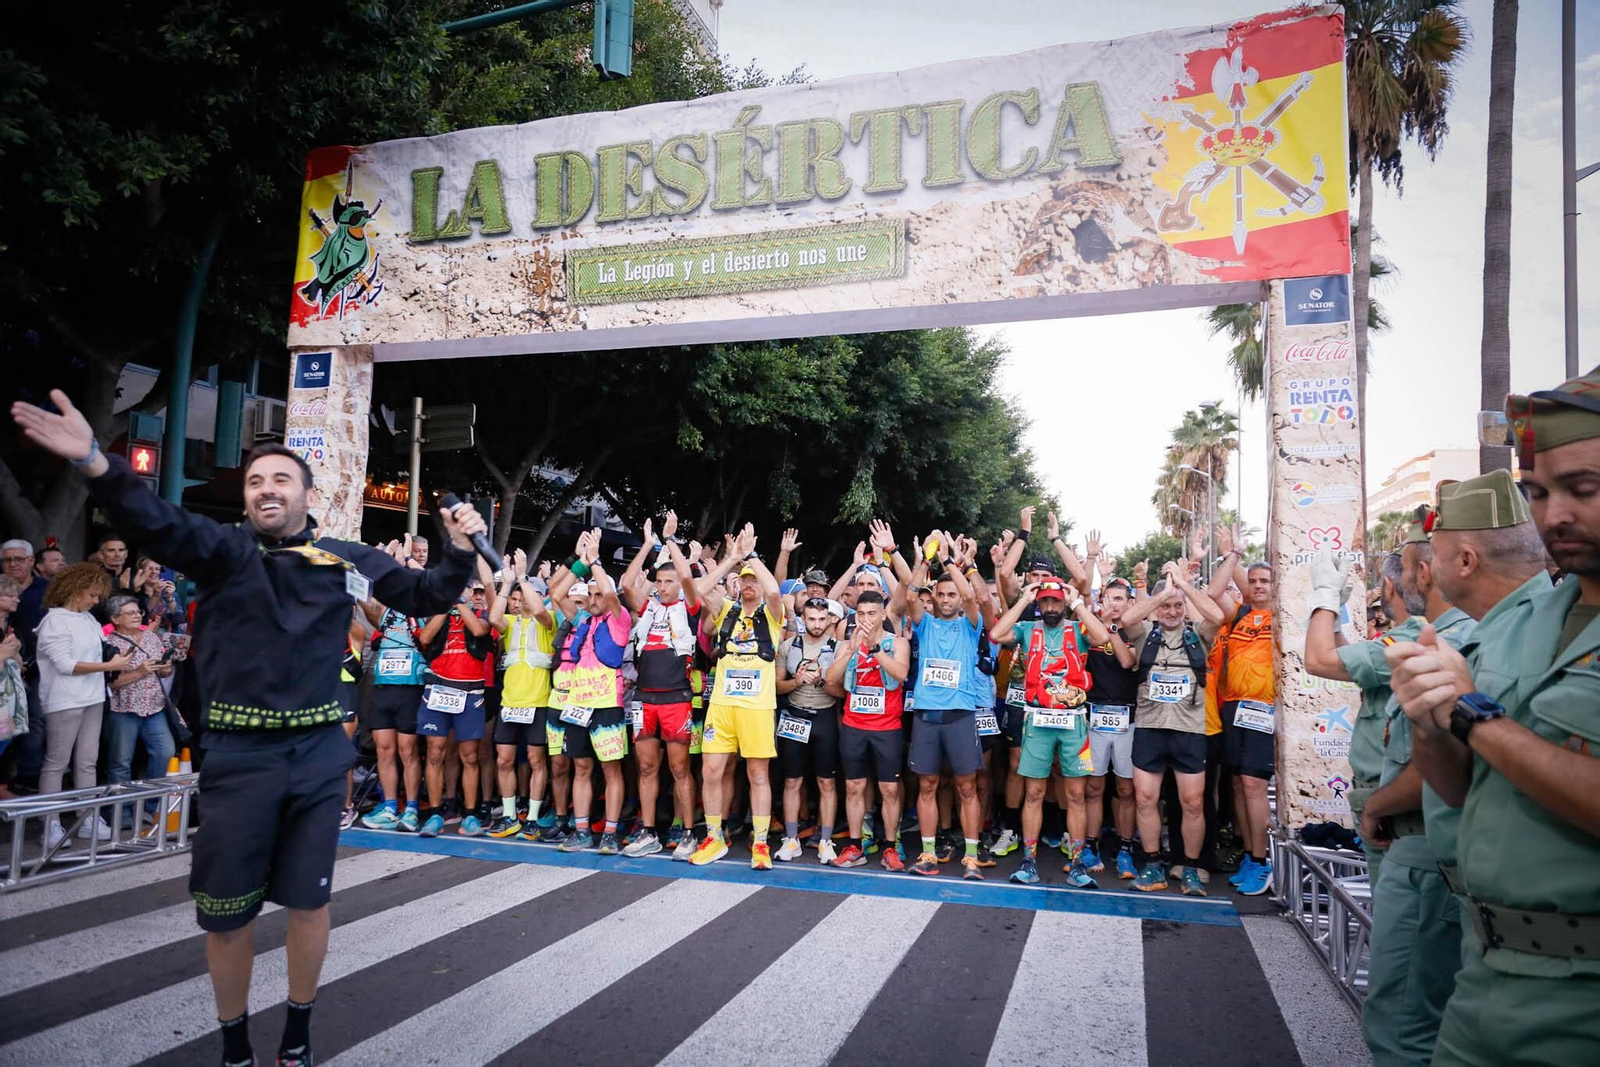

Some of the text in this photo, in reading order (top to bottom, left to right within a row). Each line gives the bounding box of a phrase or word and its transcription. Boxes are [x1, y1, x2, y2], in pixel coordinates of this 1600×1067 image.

[408, 80, 1124, 243] LA DESÉRTICA
[598, 244, 867, 285] La Legión y el desierto nos une
[1298, 301, 1335, 310] SENATOR
[1285, 340, 1351, 363] Coca-Cola
[1289, 378, 1350, 390] GRUPO
[1290, 389, 1353, 406] RENTA
[1290, 405, 1354, 425] TODO
[289, 428, 325, 436] GRUPO
[289, 437, 324, 447] RENTA
[385, 660, 407, 670] 2977
[930, 669, 954, 682] 1466
[735, 680, 753, 690] 390
[1158, 685, 1183, 696] 3341
[438, 695, 460, 708] 3338
[857, 696, 880, 708] 1008
[508, 708, 530, 717] 2082
[570, 708, 585, 720] 222
[1043, 716, 1069, 725] 3405
[1102, 716, 1120, 727] 985
[1313, 737, 1351, 747] Fundaci
[1328, 747, 1350, 758] Caix
